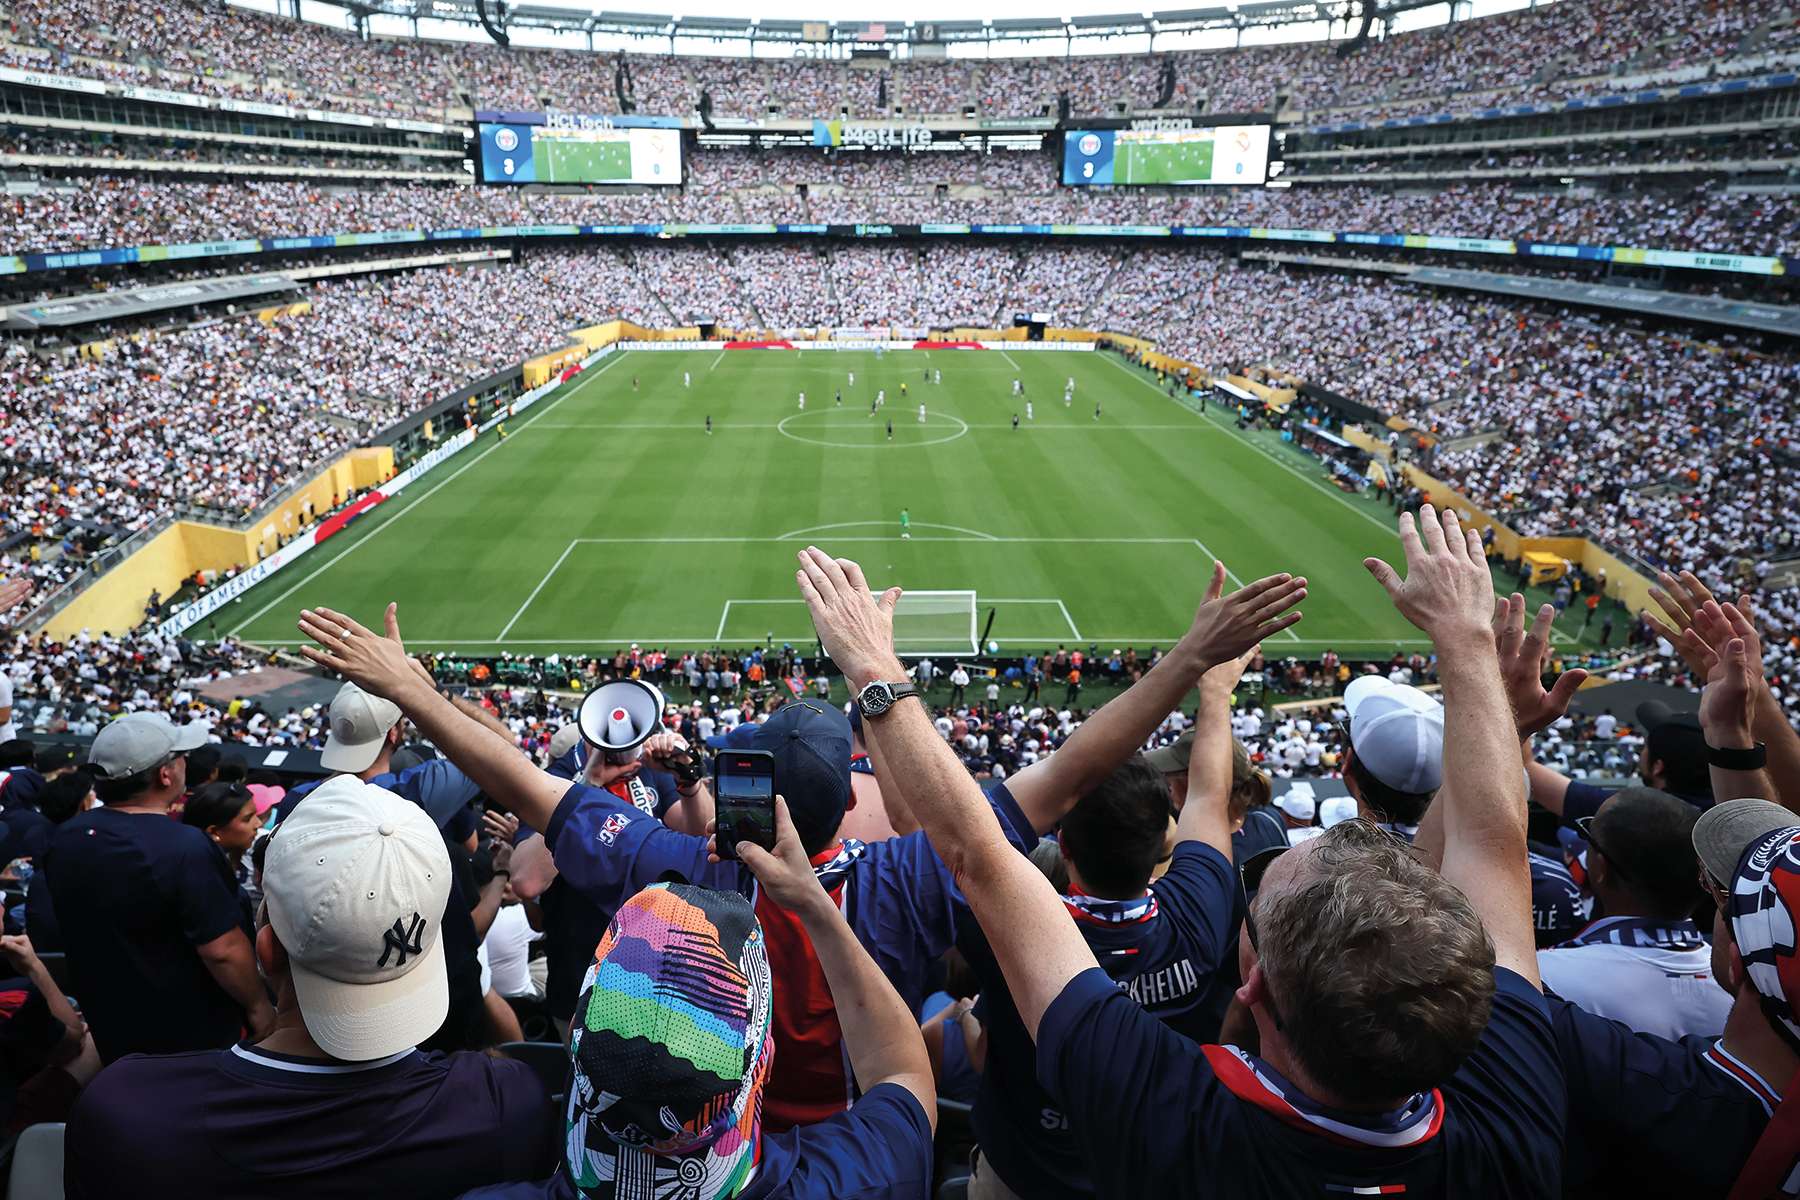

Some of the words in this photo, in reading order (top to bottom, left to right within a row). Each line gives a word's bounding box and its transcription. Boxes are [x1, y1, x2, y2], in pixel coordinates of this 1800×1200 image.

[546, 113, 613, 129] HCLTech
[1131, 116, 1192, 131] verizon
[843, 126, 932, 145] MetLife
[187, 602, 208, 622] OF
[208, 564, 267, 608] AMERICA
[377, 912, 427, 967] NY
